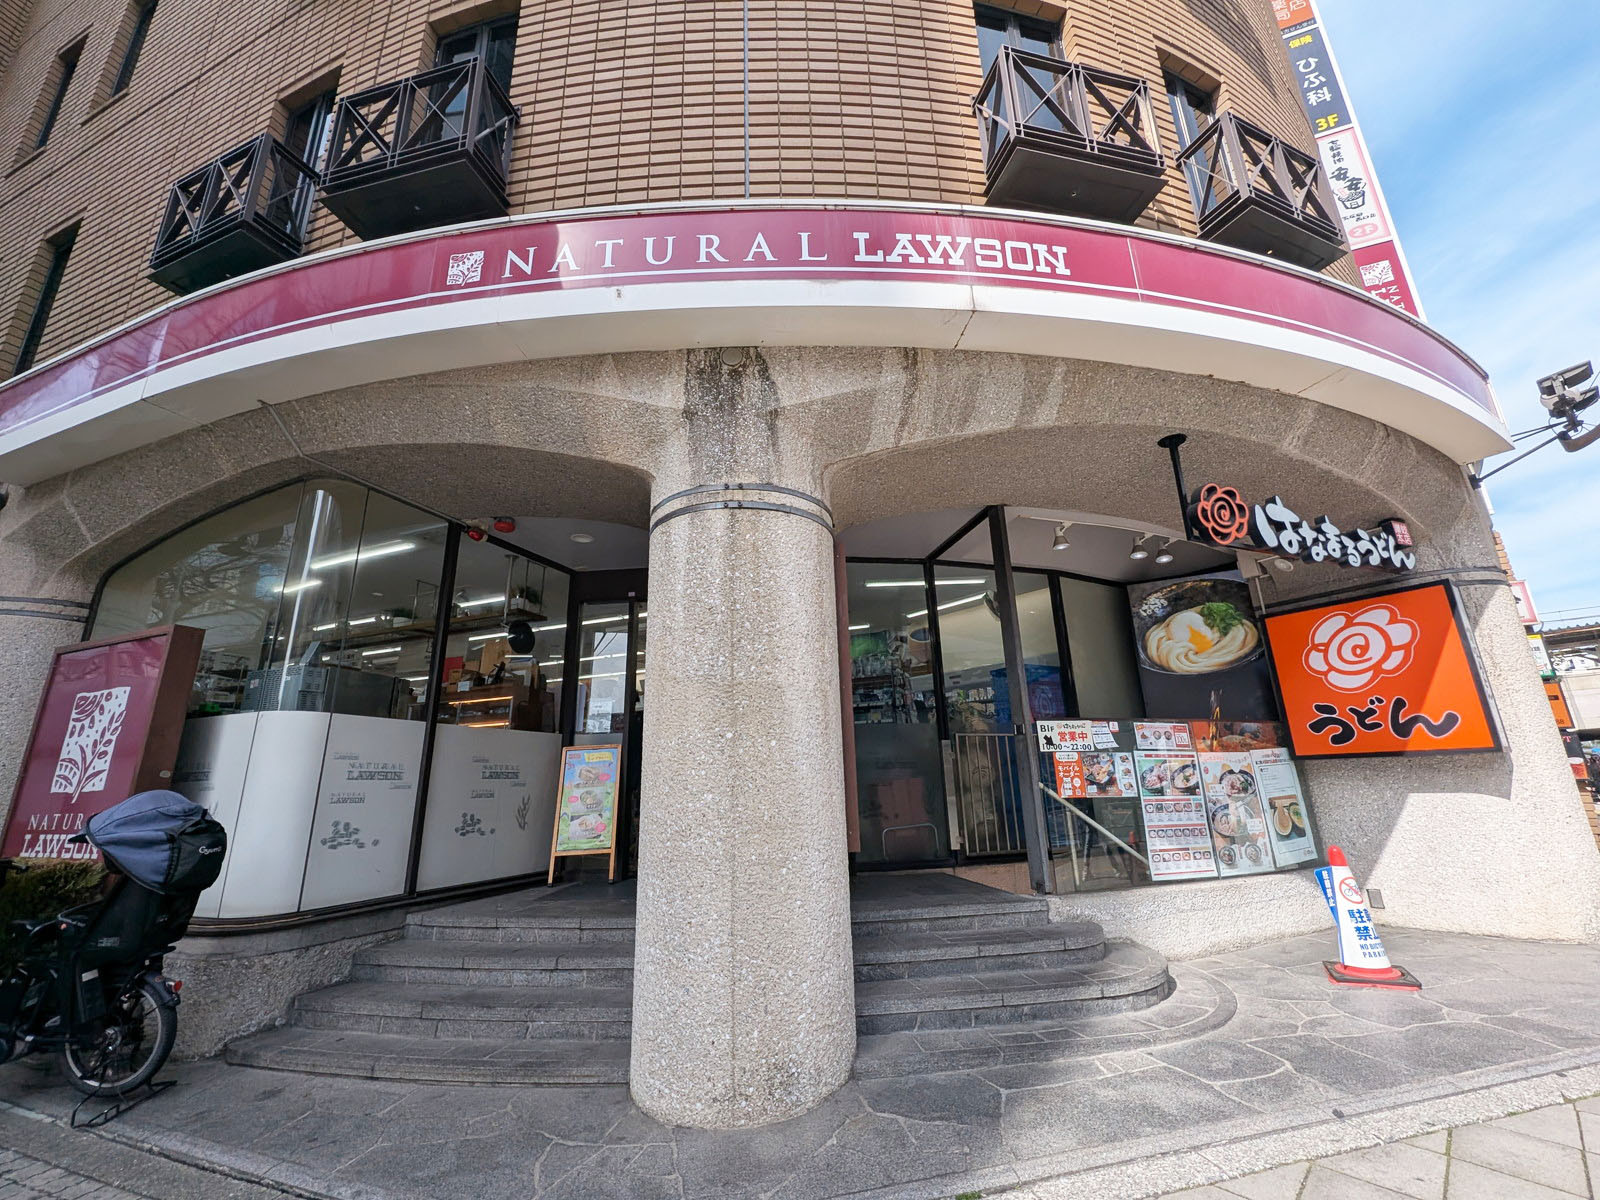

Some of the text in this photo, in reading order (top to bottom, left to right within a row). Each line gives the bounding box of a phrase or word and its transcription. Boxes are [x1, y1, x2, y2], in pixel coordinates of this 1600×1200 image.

[1296, 57, 1333, 107] ひふ科
[1315, 113, 1339, 131] 3F
[501, 231, 1071, 279] NATURAL LAWSON
[1253, 495, 1416, 570] はなまるうどん
[1307, 696, 1461, 747] うどん
[1057, 731, 1088, 742] 営業中
[346, 770, 405, 781] LAWSON
[27, 813, 84, 831] NATUR
[20, 834, 99, 859] LAWSON
